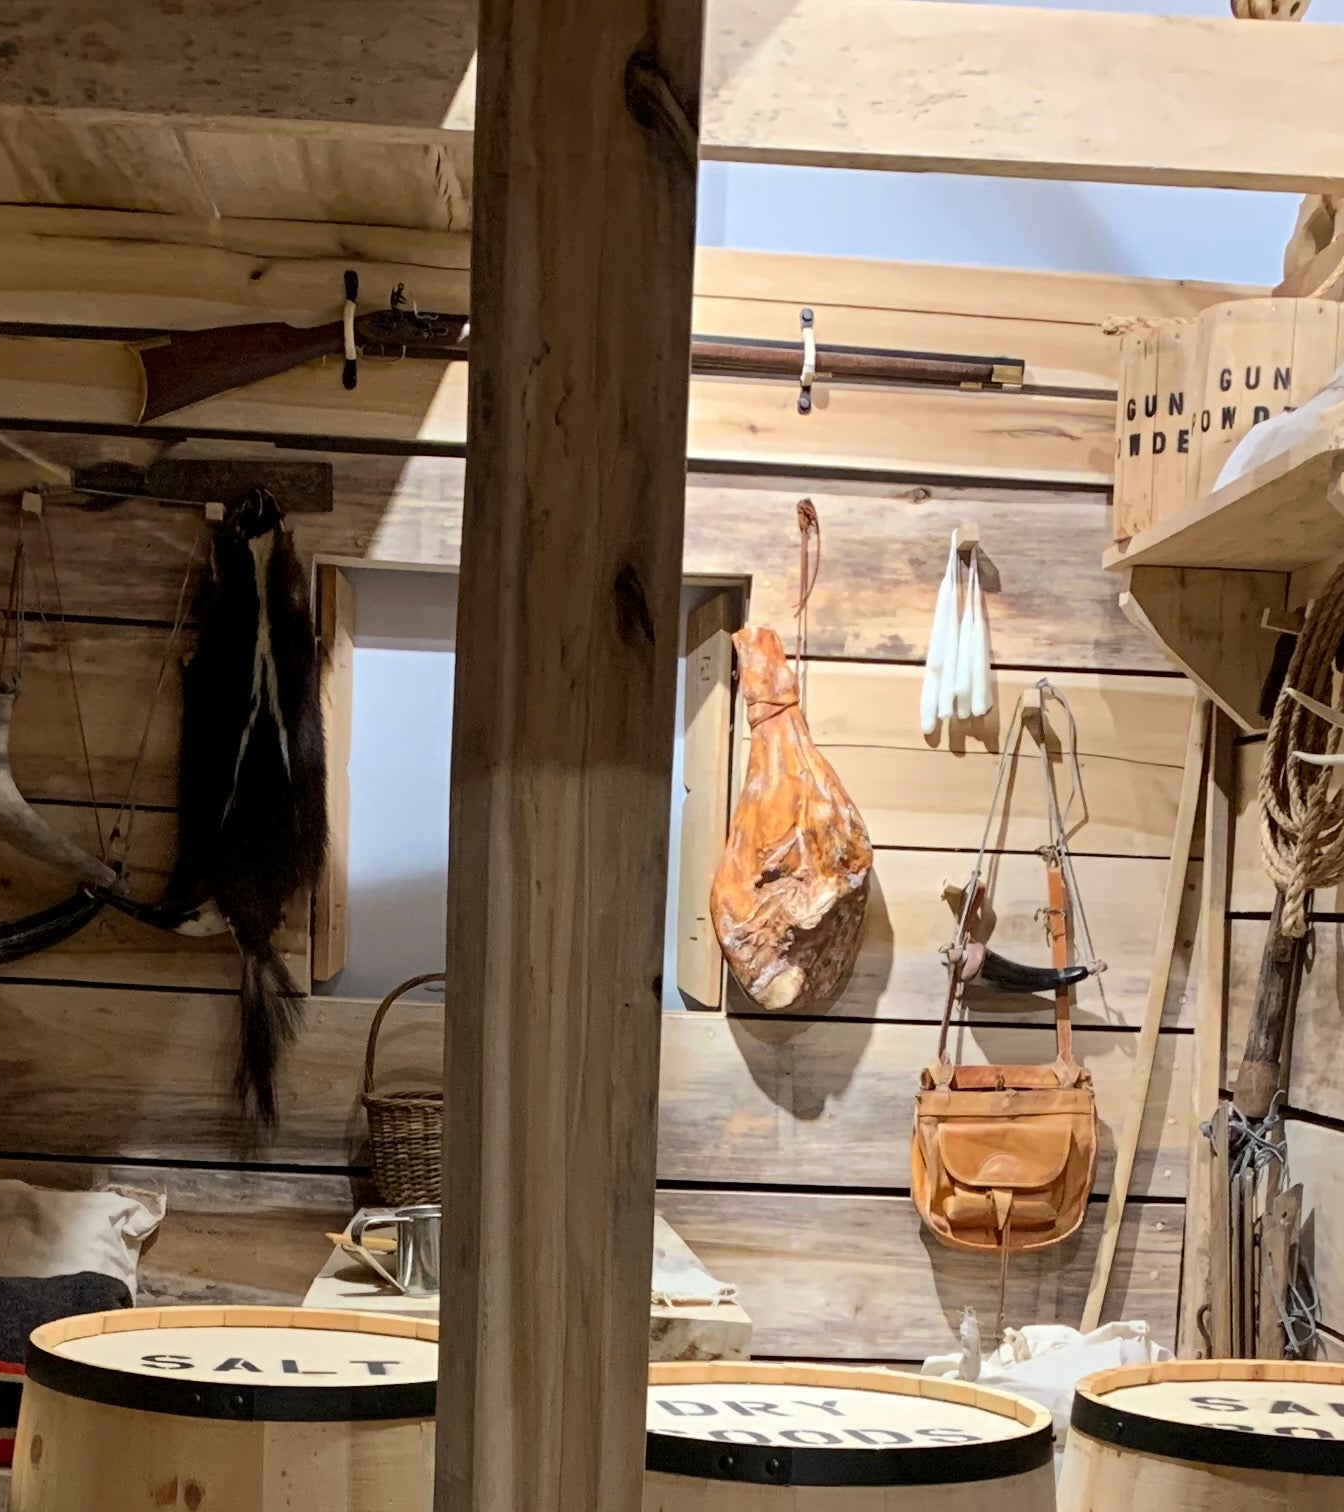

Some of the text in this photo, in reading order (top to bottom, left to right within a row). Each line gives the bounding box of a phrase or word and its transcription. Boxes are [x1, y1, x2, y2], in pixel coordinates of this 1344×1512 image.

[1220, 366, 1291, 392] GUN
[1127, 392, 1184, 421] GUN
[1191, 406, 1298, 436] POWD
[140, 1354, 401, 1376] SALT
[655, 1399, 847, 1417] DRY
[646, 1427, 984, 1446] OODS
